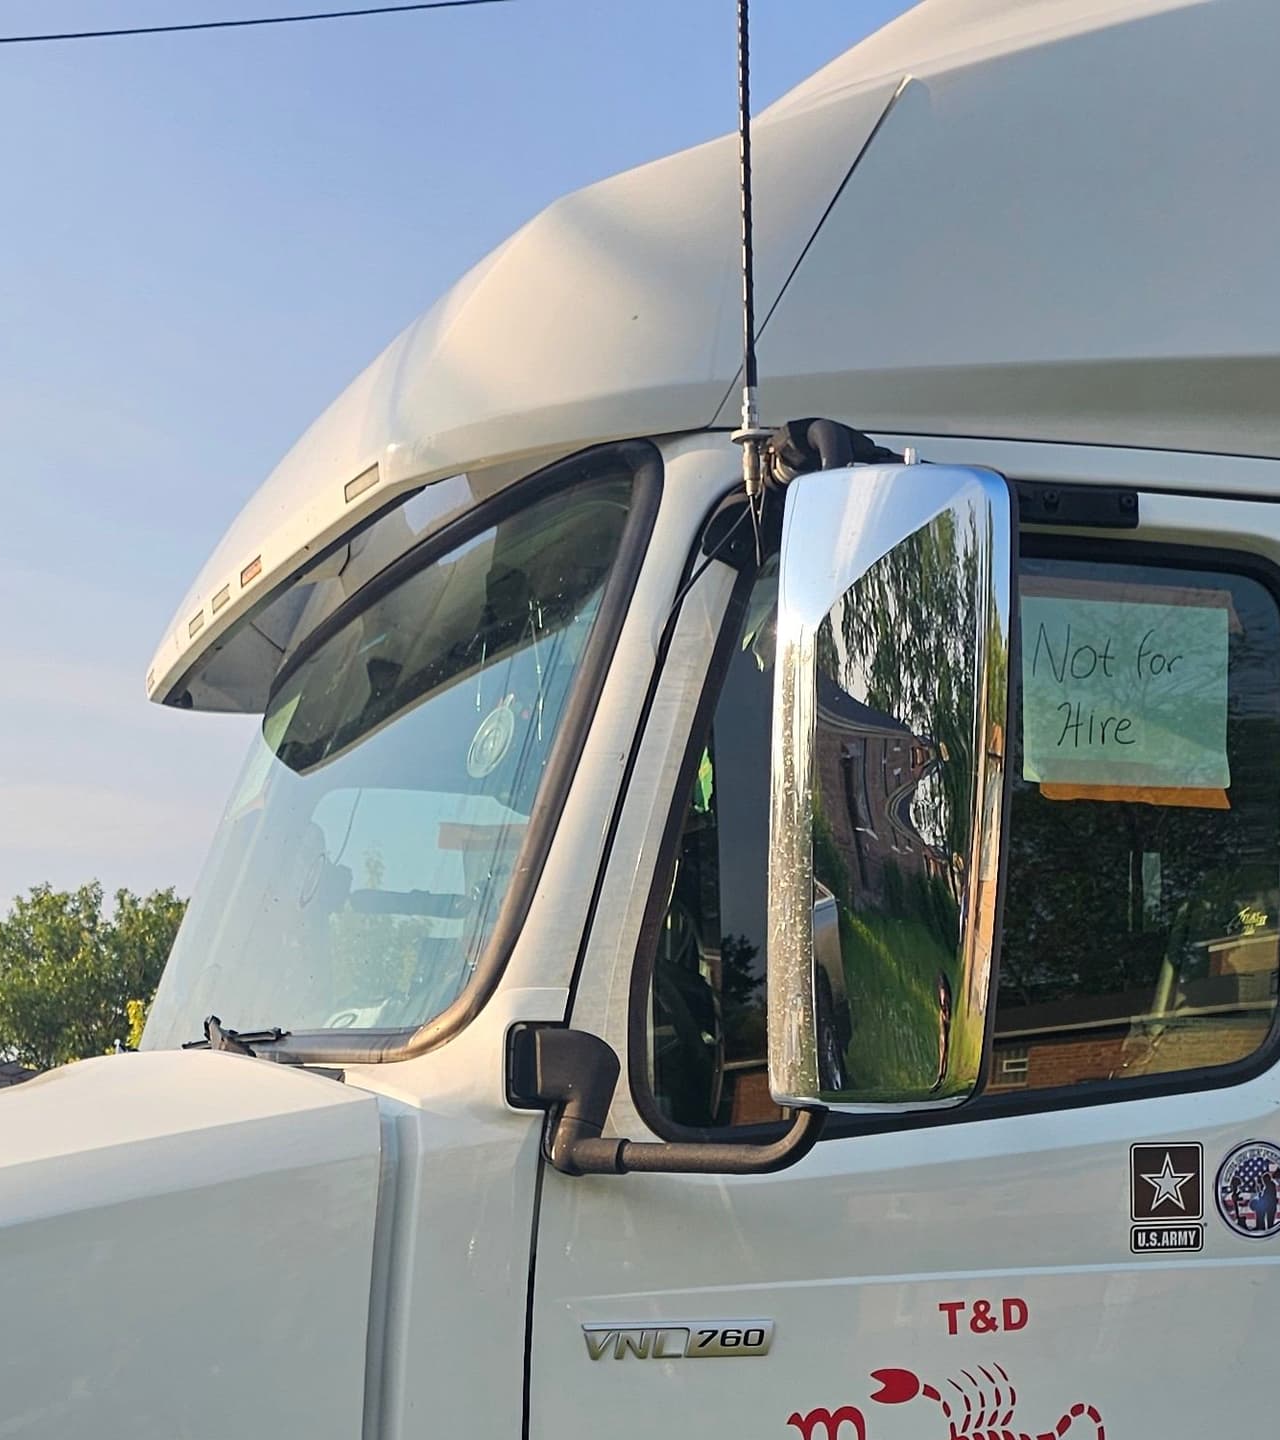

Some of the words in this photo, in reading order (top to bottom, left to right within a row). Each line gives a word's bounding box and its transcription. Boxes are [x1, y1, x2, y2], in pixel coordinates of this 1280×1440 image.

[1031, 622, 1115, 684] Not
[1056, 702, 1136, 748] Hire
[938, 1297, 1029, 1335] T&D
[584, 1329, 683, 1361] VNL
[697, 1328, 766, 1348] 760
